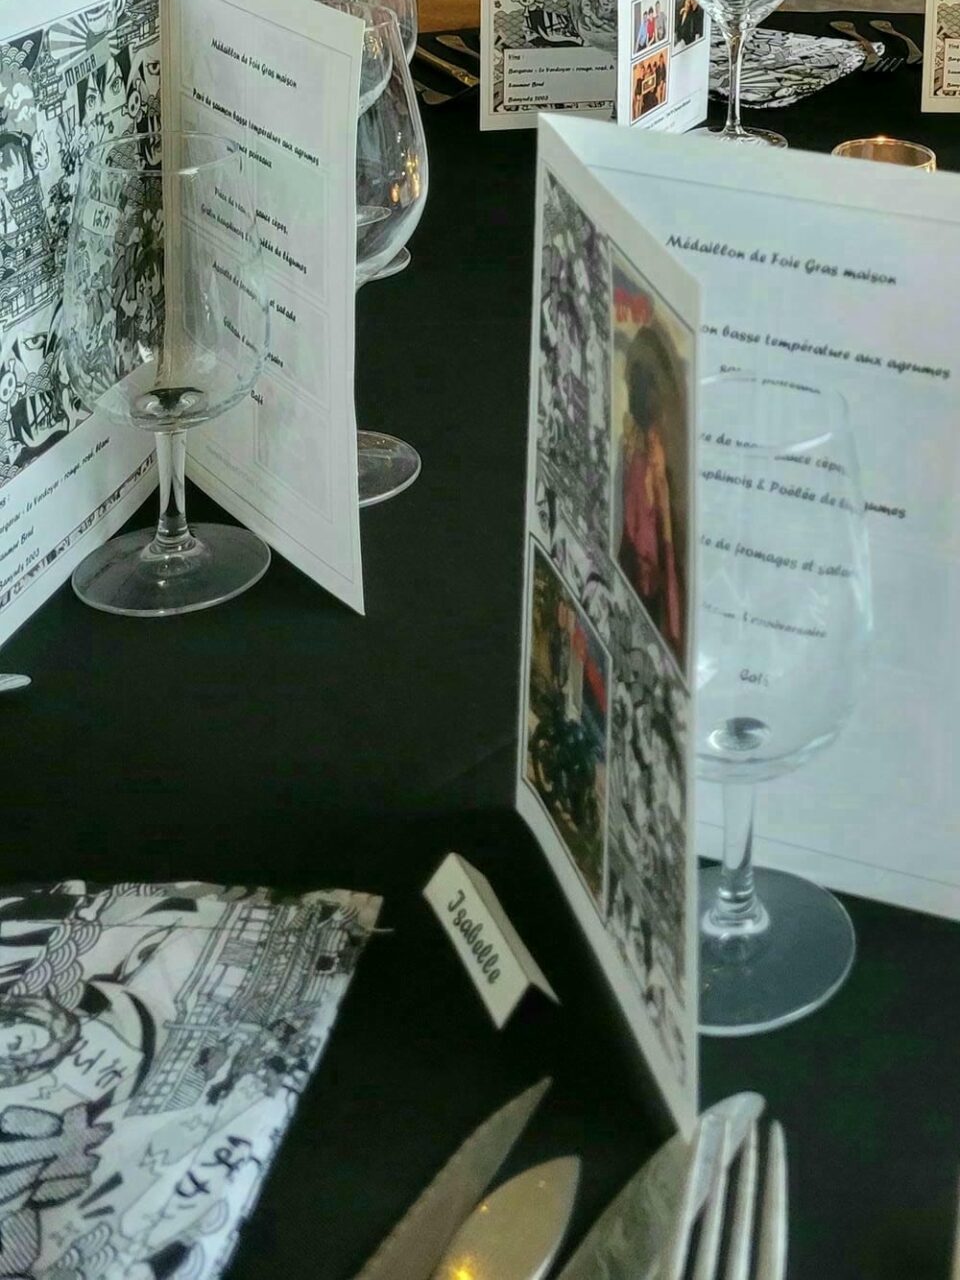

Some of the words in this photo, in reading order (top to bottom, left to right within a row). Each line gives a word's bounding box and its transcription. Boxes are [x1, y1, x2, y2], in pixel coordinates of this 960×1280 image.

[666, 234, 745, 260] Médaillon
[750, 249, 766, 263] de
[771, 252, 800, 270] Foie
[804, 258, 839, 277] Gras
[843, 267, 897, 286] maison
[722, 325, 761, 344] basse
[765, 333, 851, 361] température
[854, 353, 882, 368] aux
[887, 359, 951, 379] agrumes
[716, 433, 732, 446] de
[702, 470, 752, 489] uphinois
[769, 481, 816, 501] Poêlée
[820, 492, 837, 507] de
[715, 538, 731, 551] de
[734, 542, 798, 569] fromages
[448, 889, 501, 986] Isabelle
